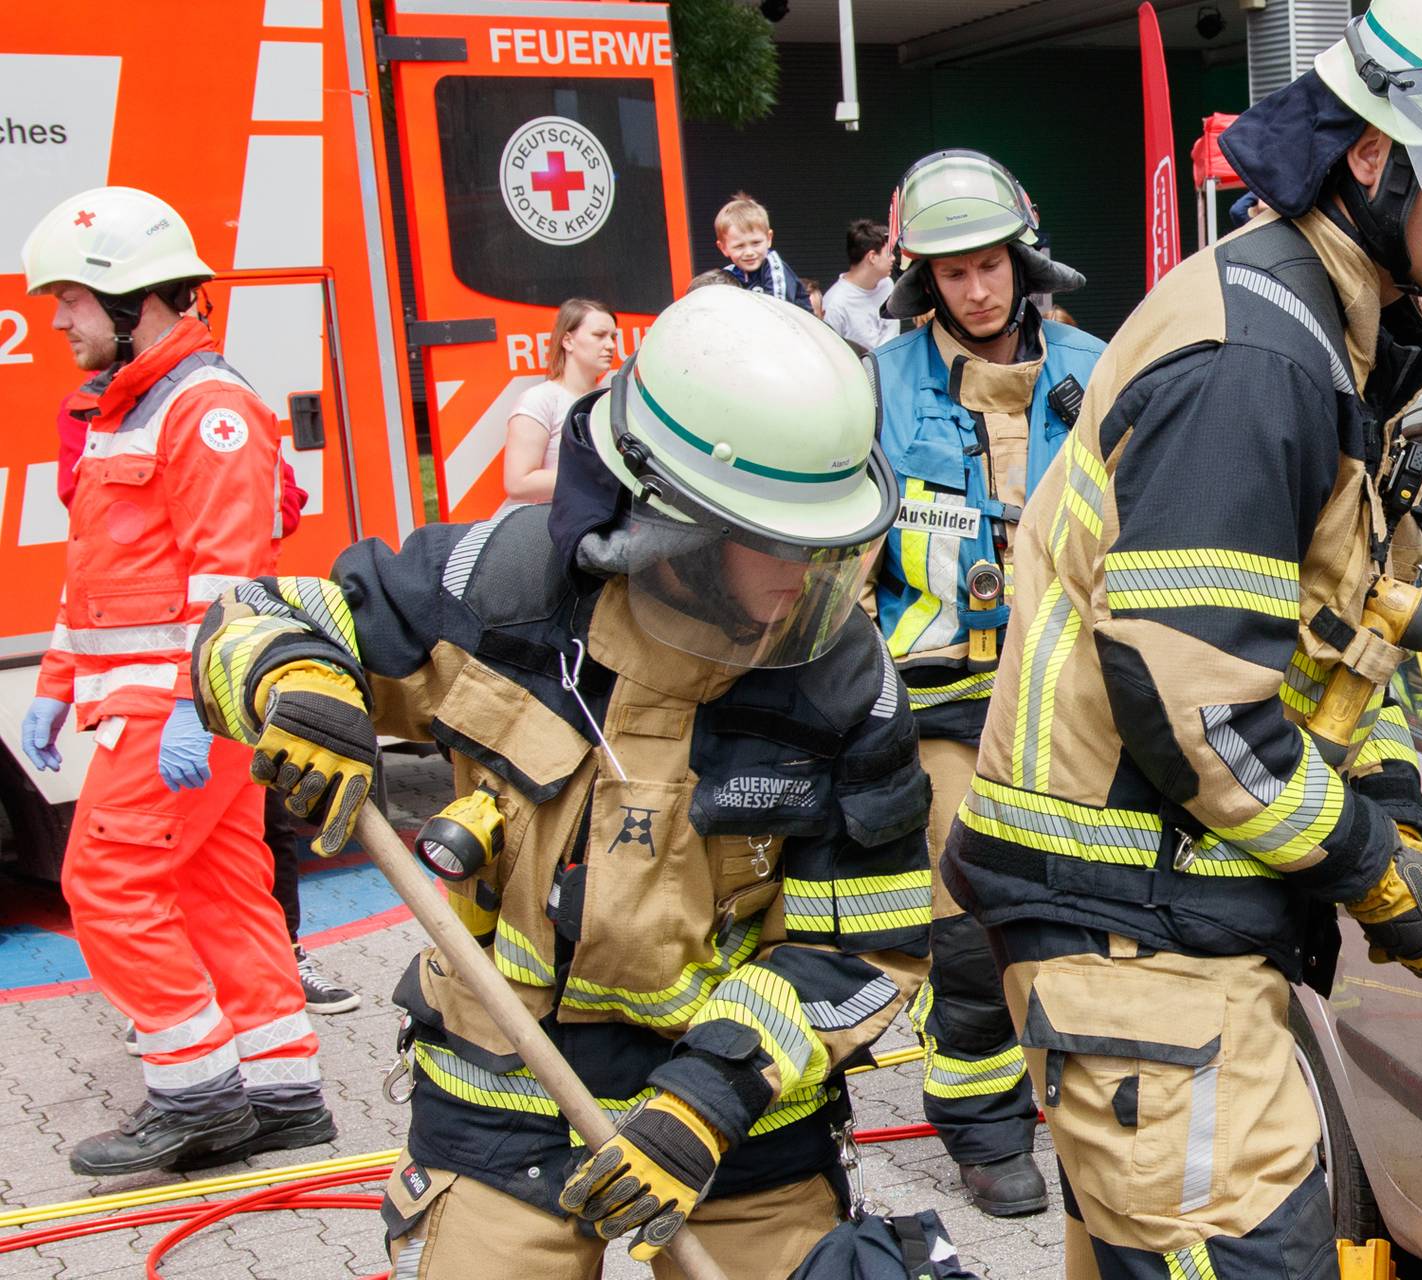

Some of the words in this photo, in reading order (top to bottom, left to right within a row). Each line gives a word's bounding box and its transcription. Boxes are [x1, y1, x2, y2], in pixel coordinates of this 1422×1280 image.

[511, 128, 601, 170] DEUTSCHES
[512, 184, 558, 234] ROTES
[565, 184, 605, 234] KREUZ
[899, 505, 976, 531] Ausbilder
